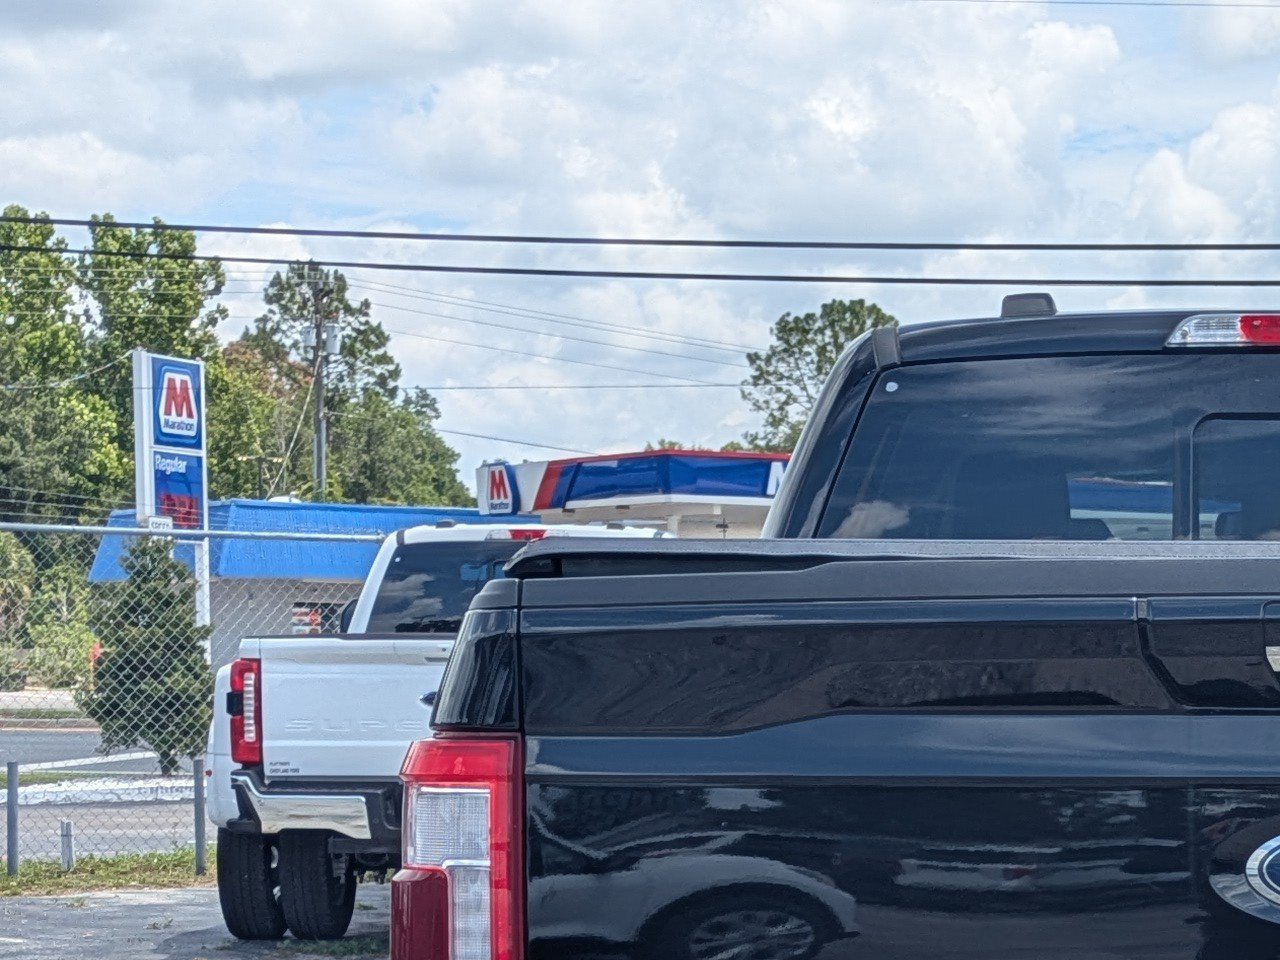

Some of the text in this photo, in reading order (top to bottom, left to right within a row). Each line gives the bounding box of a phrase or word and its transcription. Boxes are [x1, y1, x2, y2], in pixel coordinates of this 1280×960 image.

[164, 377, 194, 419] M
[163, 417, 194, 431] Marathon
[155, 454, 188, 475] Regular
[490, 470, 508, 500] M
